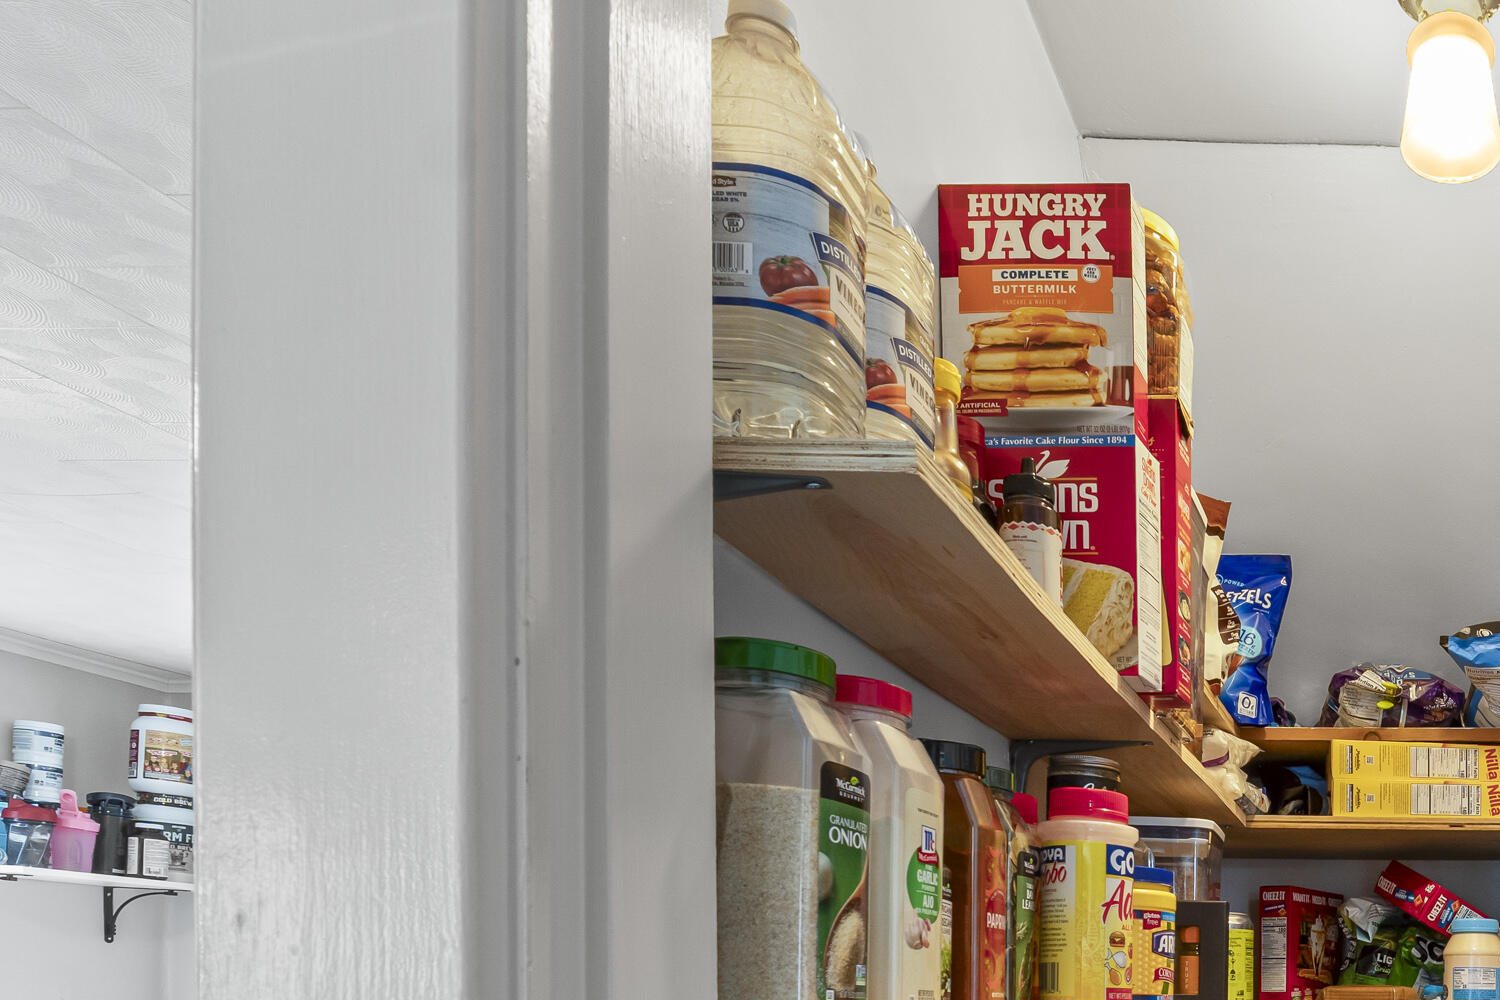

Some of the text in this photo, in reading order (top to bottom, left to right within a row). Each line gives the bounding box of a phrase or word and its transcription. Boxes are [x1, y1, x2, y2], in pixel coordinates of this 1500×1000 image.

[968, 193, 1106, 217] HUNGRY
[961, 219, 1110, 261] JACK
[820, 241, 862, 283] DISTILLED
[1001, 270, 1069, 279] COMPLETE
[993, 285, 1077, 294] BUTTERMILK
[899, 344, 932, 377] DISTILLED
[1001, 437, 1033, 445] Favorite
[1036, 437, 1056, 445] Cake
[1082, 436, 1104, 444] Since
[1106, 436, 1127, 444] 1894
[988, 483, 1099, 514] Sns
[1224, 578, 1245, 588] POWER
[1484, 748, 1498, 780] Nilla
[836, 777, 865, 797] McCormick
[1487, 785, 1500, 817] Nilla
[829, 814, 868, 834] GRANULATED
[828, 826, 868, 851] ONION
[917, 870, 938, 886] GARLIC
[1143, 912, 1161, 920] gluten
[1146, 918, 1158, 926] free
